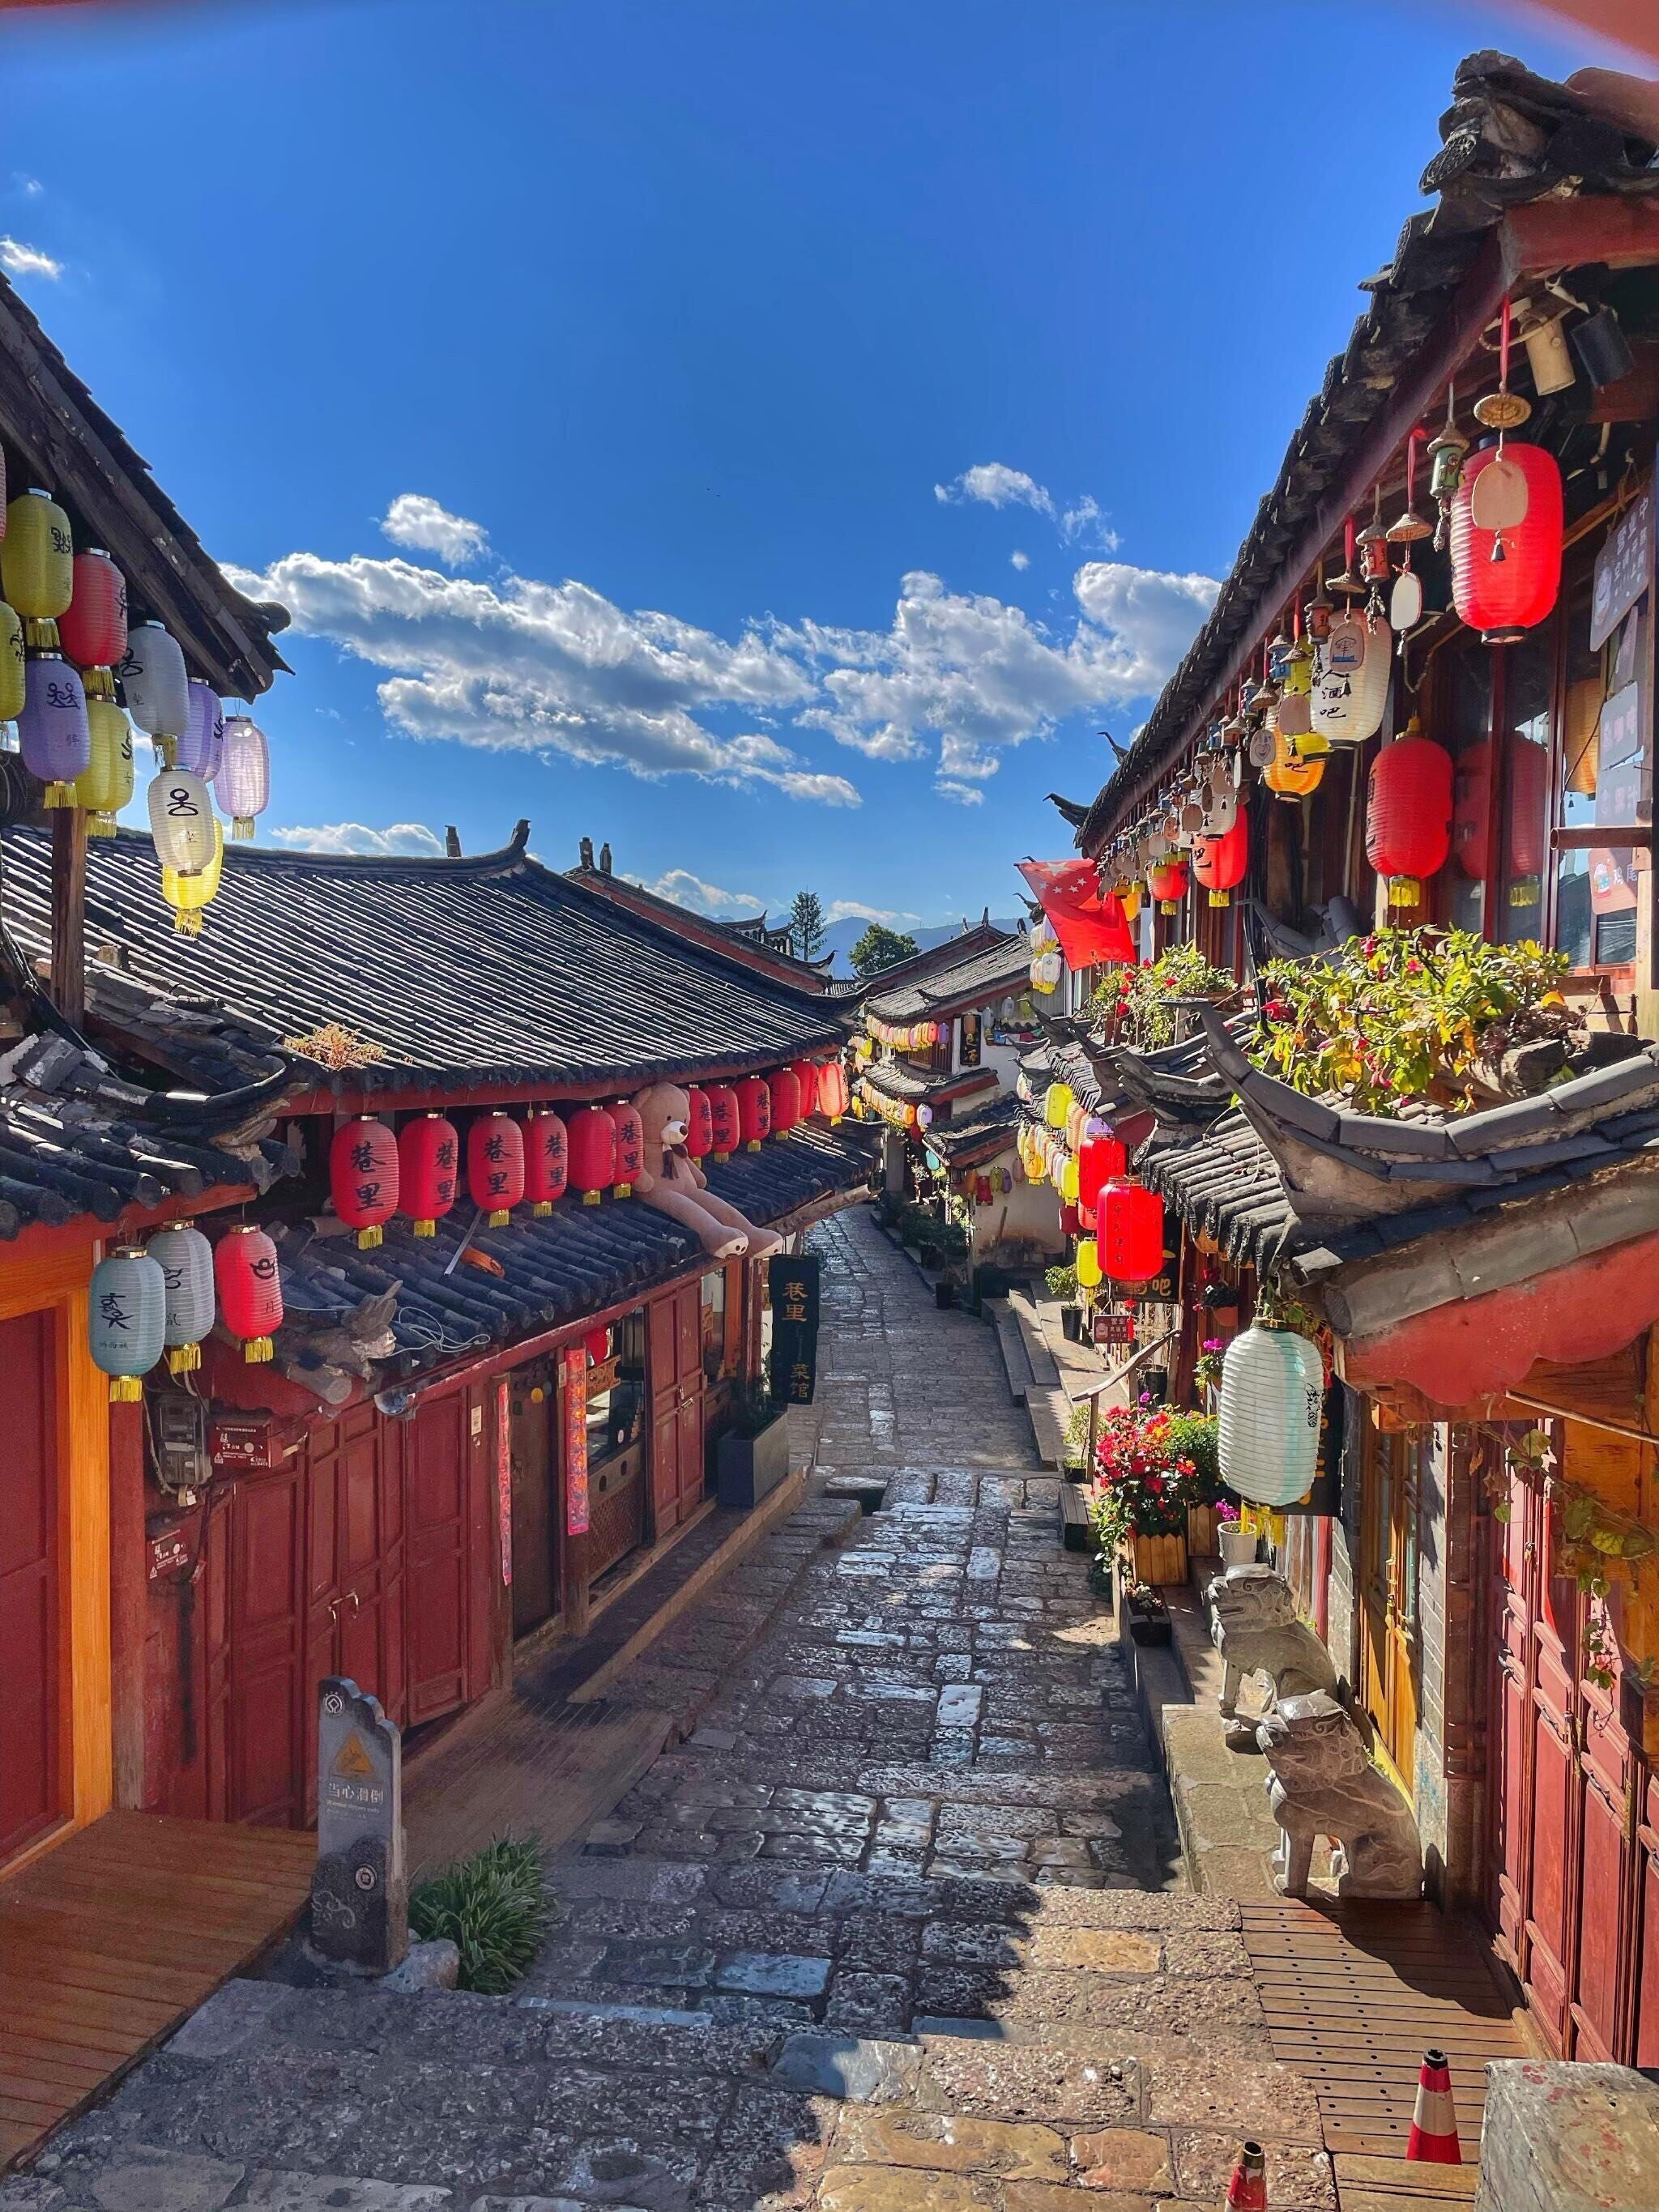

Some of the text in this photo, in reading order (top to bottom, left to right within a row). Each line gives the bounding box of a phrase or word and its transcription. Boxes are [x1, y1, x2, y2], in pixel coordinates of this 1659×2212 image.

[619, 1120, 642, 1174] 巷里
[714, 1100, 732, 1145] 巷里
[350, 1140, 387, 1213] 巷里
[433, 1138, 458, 1206] 巷里
[482, 1133, 512, 1196] 巷里
[544, 1131, 566, 1190] 巷里
[781, 1281, 809, 1322] 巷里
[790, 1363, 810, 1399] 菜馆
[328, 1782, 384, 1805] 当心滑倒
